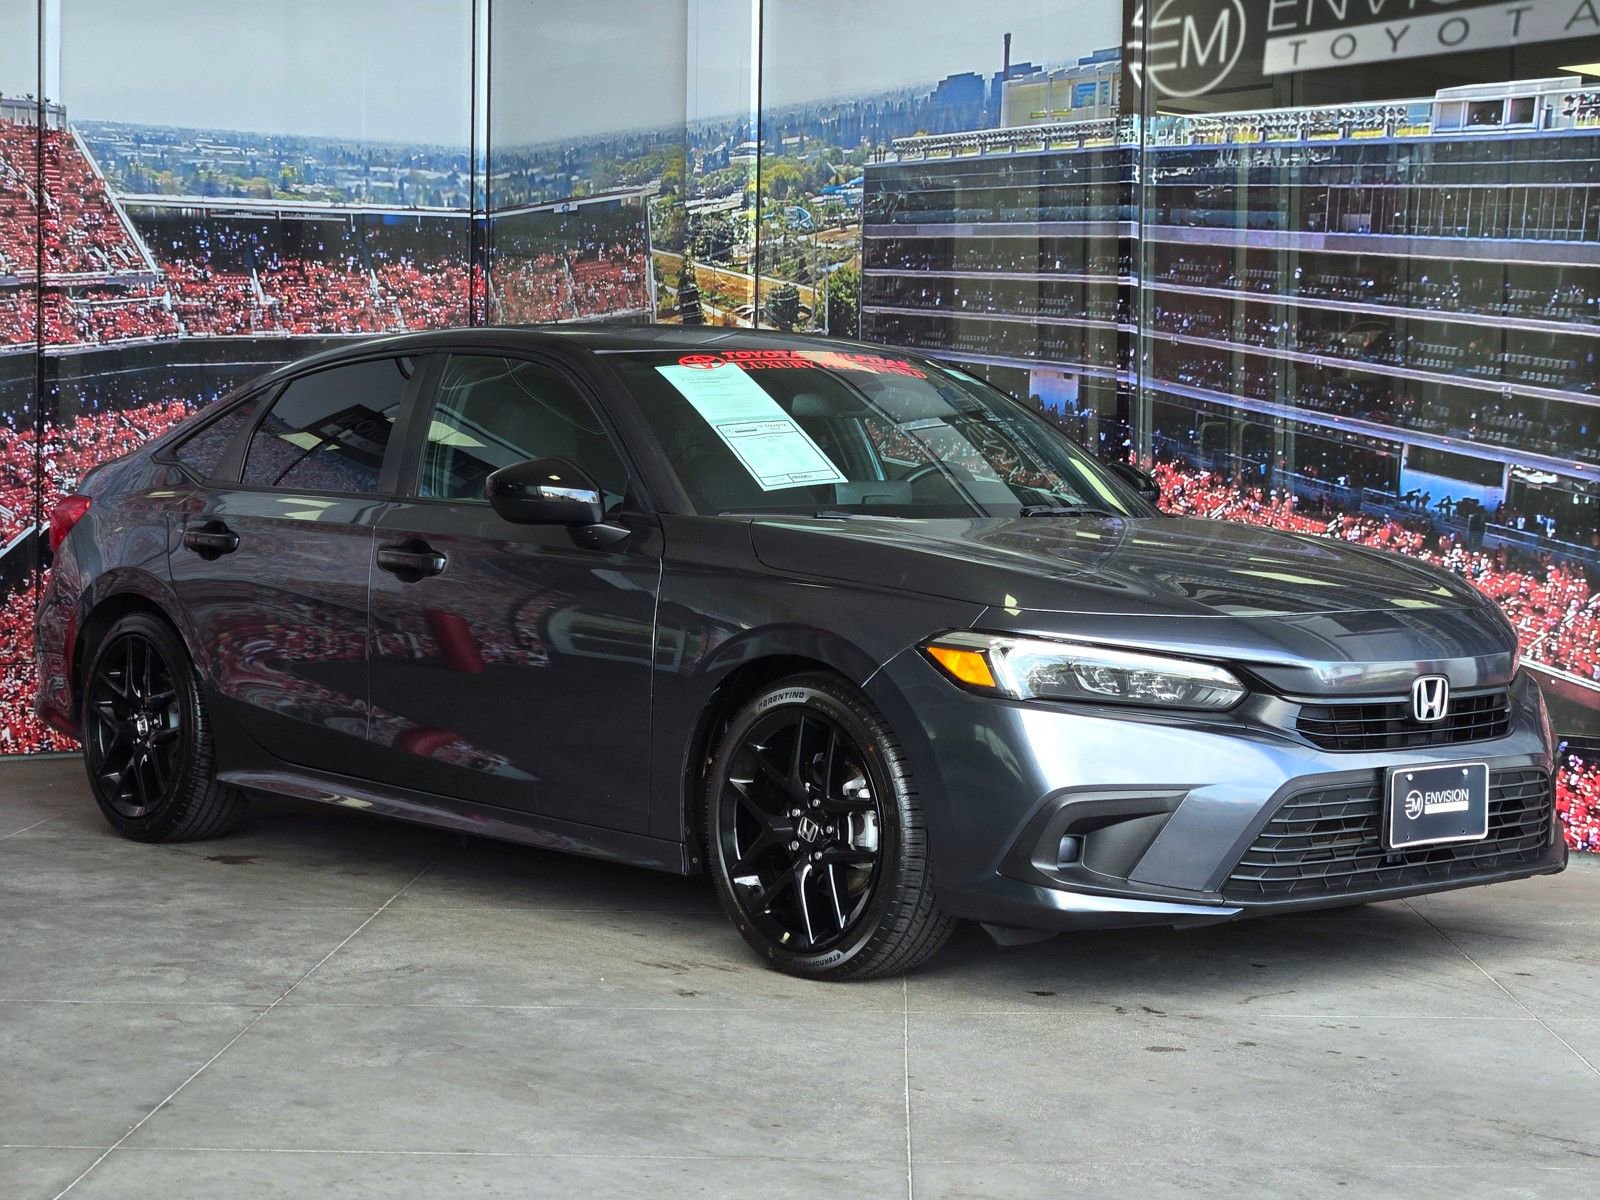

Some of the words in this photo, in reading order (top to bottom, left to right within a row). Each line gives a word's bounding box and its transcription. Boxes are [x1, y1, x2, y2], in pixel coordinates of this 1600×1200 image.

[1288, 0, 1600, 66] TOYOTA
[721, 350, 806, 360] TOYOTA
[737, 360, 817, 370] LUXURY
[1425, 788, 1469, 805] ENVISION
